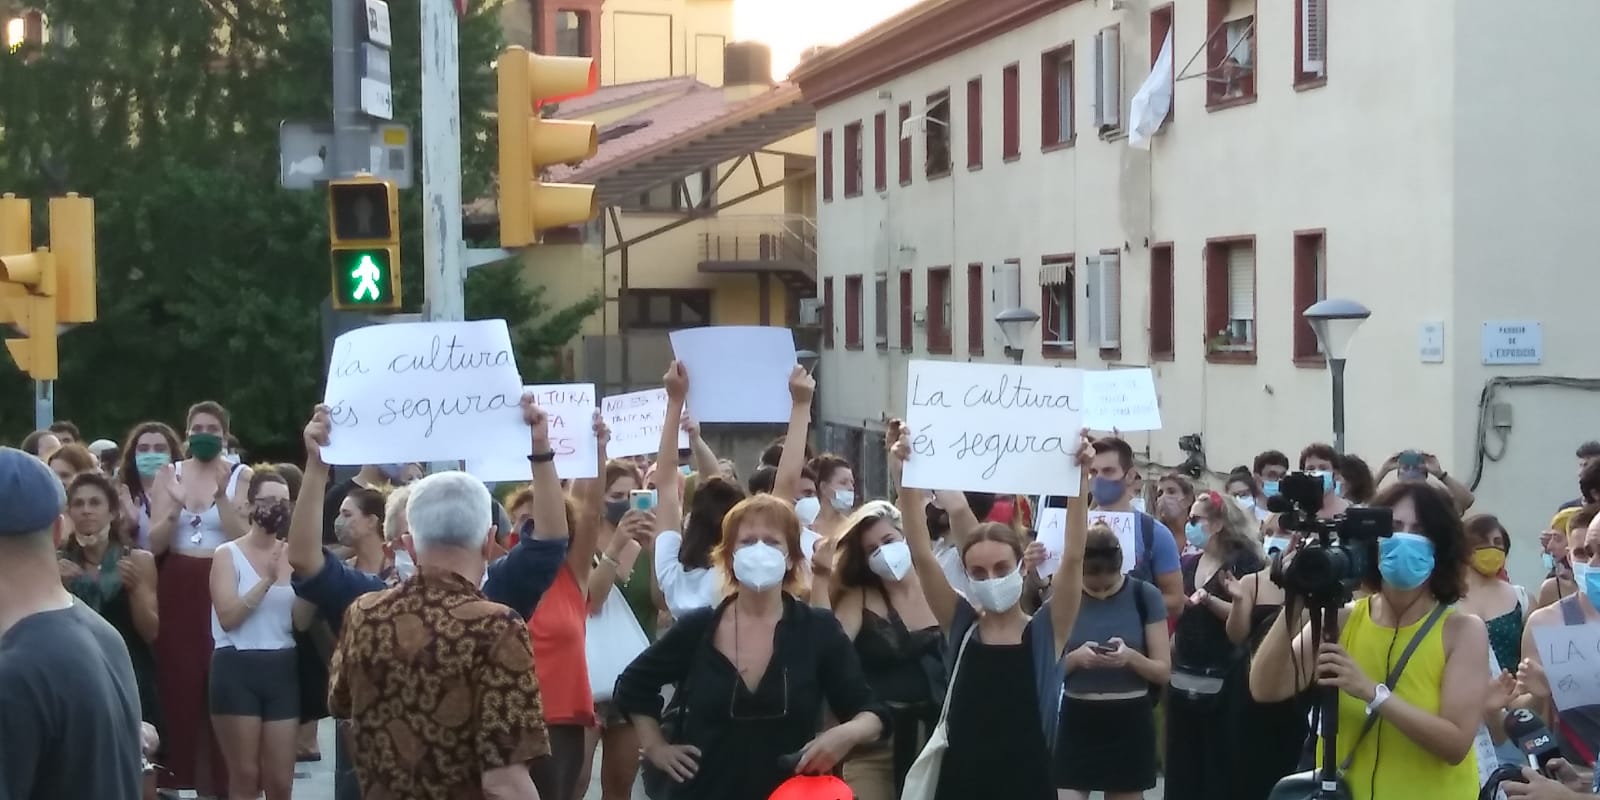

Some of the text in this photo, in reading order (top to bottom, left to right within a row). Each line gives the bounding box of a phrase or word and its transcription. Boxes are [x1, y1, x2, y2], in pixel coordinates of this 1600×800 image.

[387, 335, 510, 373] cultura
[912, 374, 1080, 412] La cultura
[378, 390, 521, 438] segura
[912, 424, 1078, 480] és segura
[1549, 640, 1586, 665] LA
